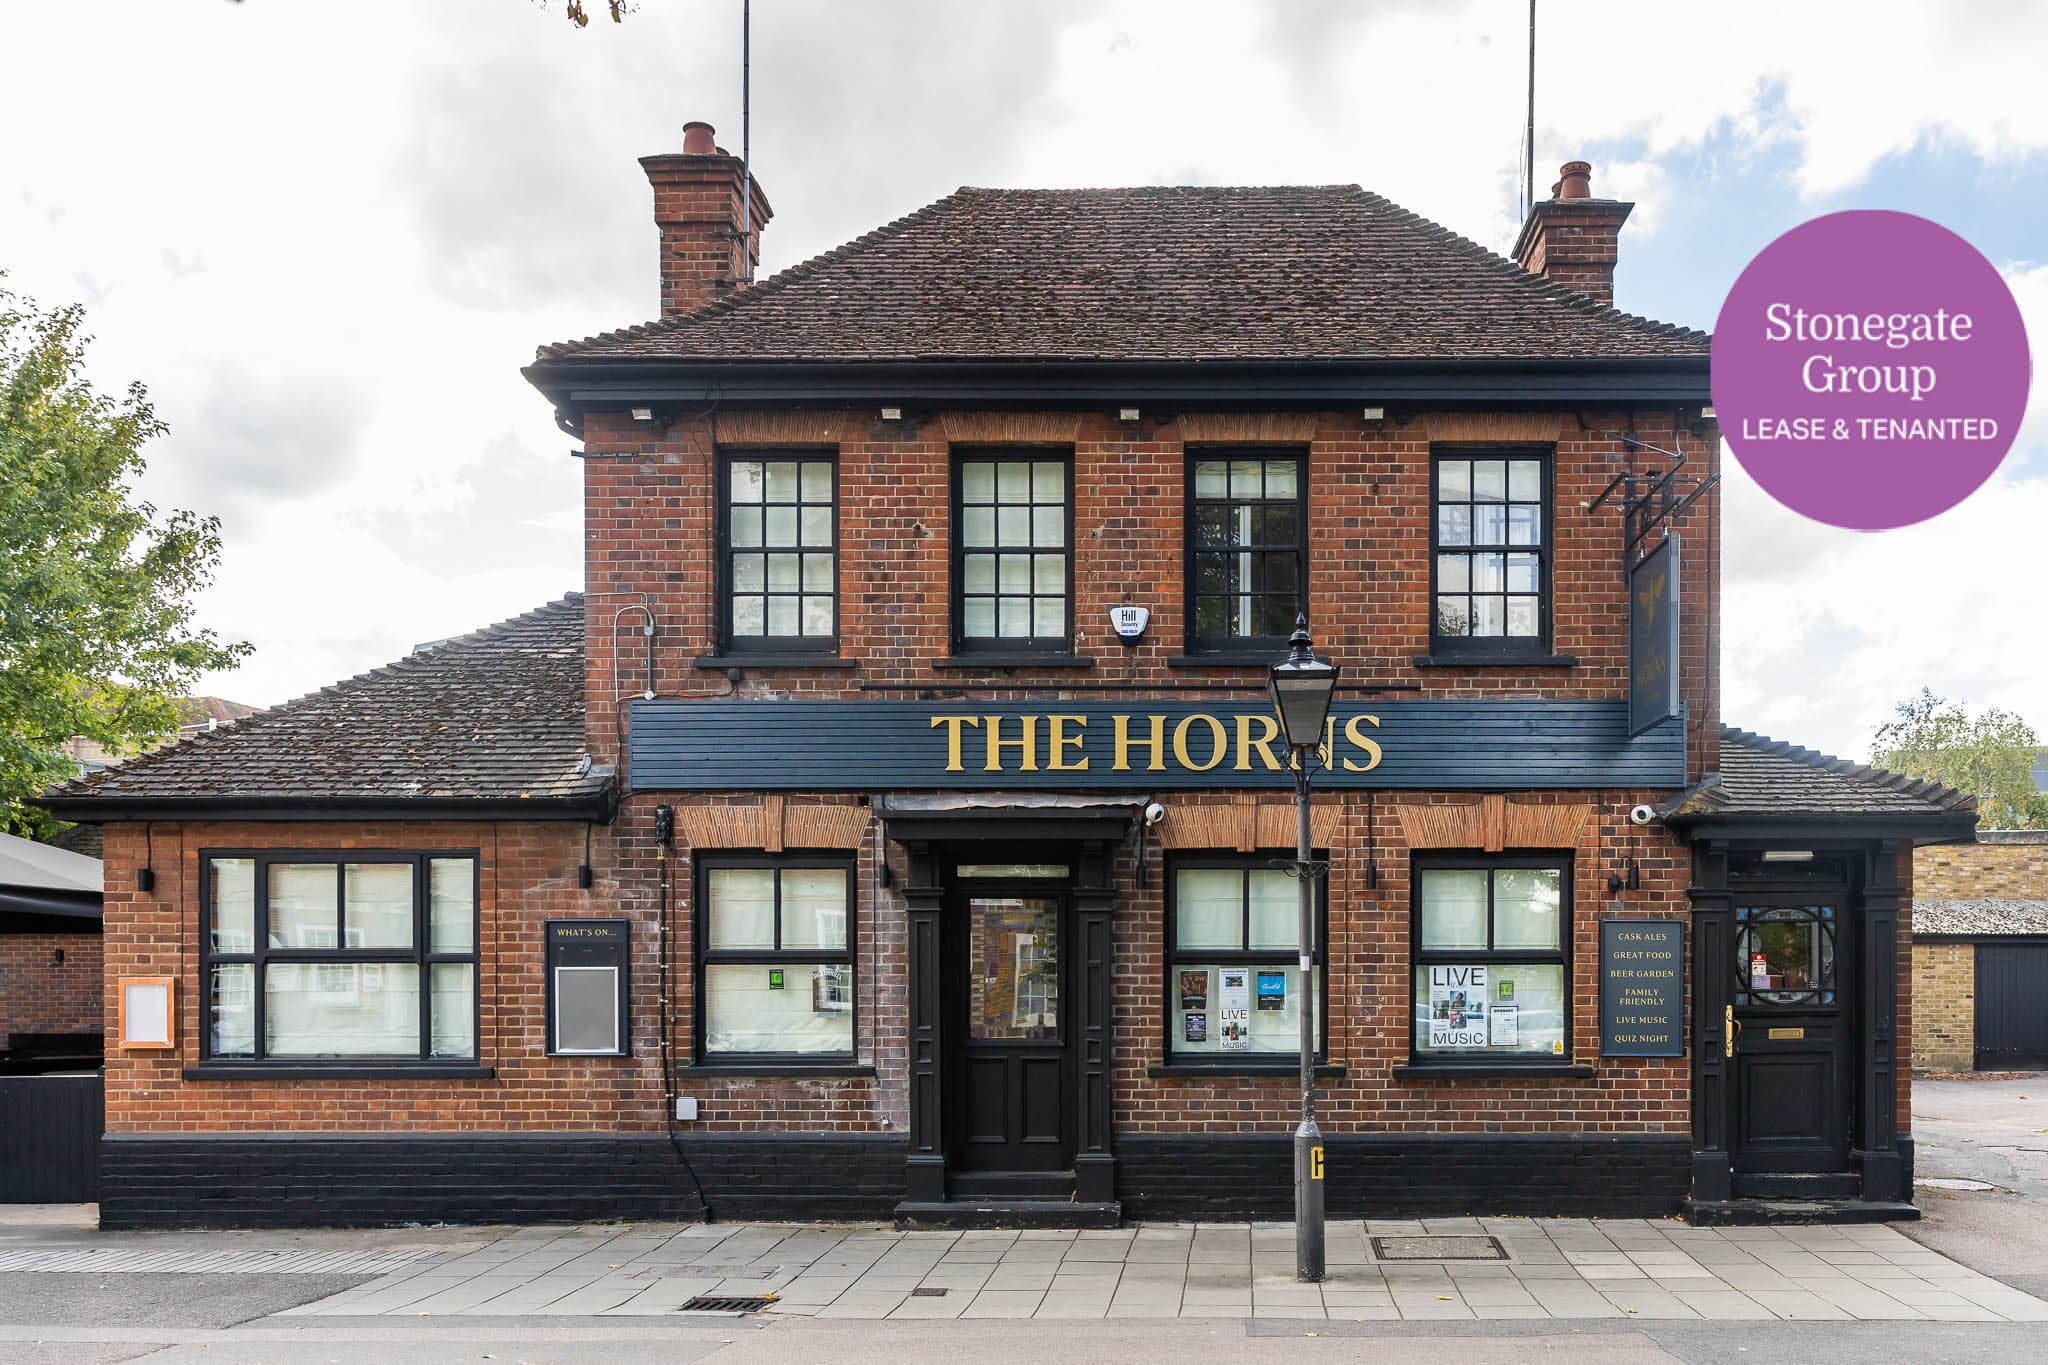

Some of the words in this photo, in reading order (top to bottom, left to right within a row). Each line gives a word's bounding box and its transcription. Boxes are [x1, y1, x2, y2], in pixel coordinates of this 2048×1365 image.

[1121, 609, 1137, 622] Hill
[930, 714, 1089, 772] THE
[557, 928, 593, 937] WHAT'S
[1617, 932, 1642, 941] CASK
[1644, 932, 1667, 941] ALES
[1613, 951, 1643, 960] GREAT
[1646, 951, 1672, 960] FOOD
[1433, 967, 1485, 986] LIVE
[1610, 970, 1634, 978] BEER
[1636, 970, 1674, 978] GARDEN
[1625, 988, 1660, 996] FAMILY
[1619, 997, 1665, 1006] FRIENDLY
[1221, 1009, 1248, 1020] LIVE
[1616, 1016, 1637, 1024] LIVE
[1639, 1016, 1668, 1024] MUSIC
[1433, 1032, 1484, 1045] MUSIC
[1614, 1034, 1637, 1043] QUIZ
[1639, 1034, 1668, 1043] NIGHT
